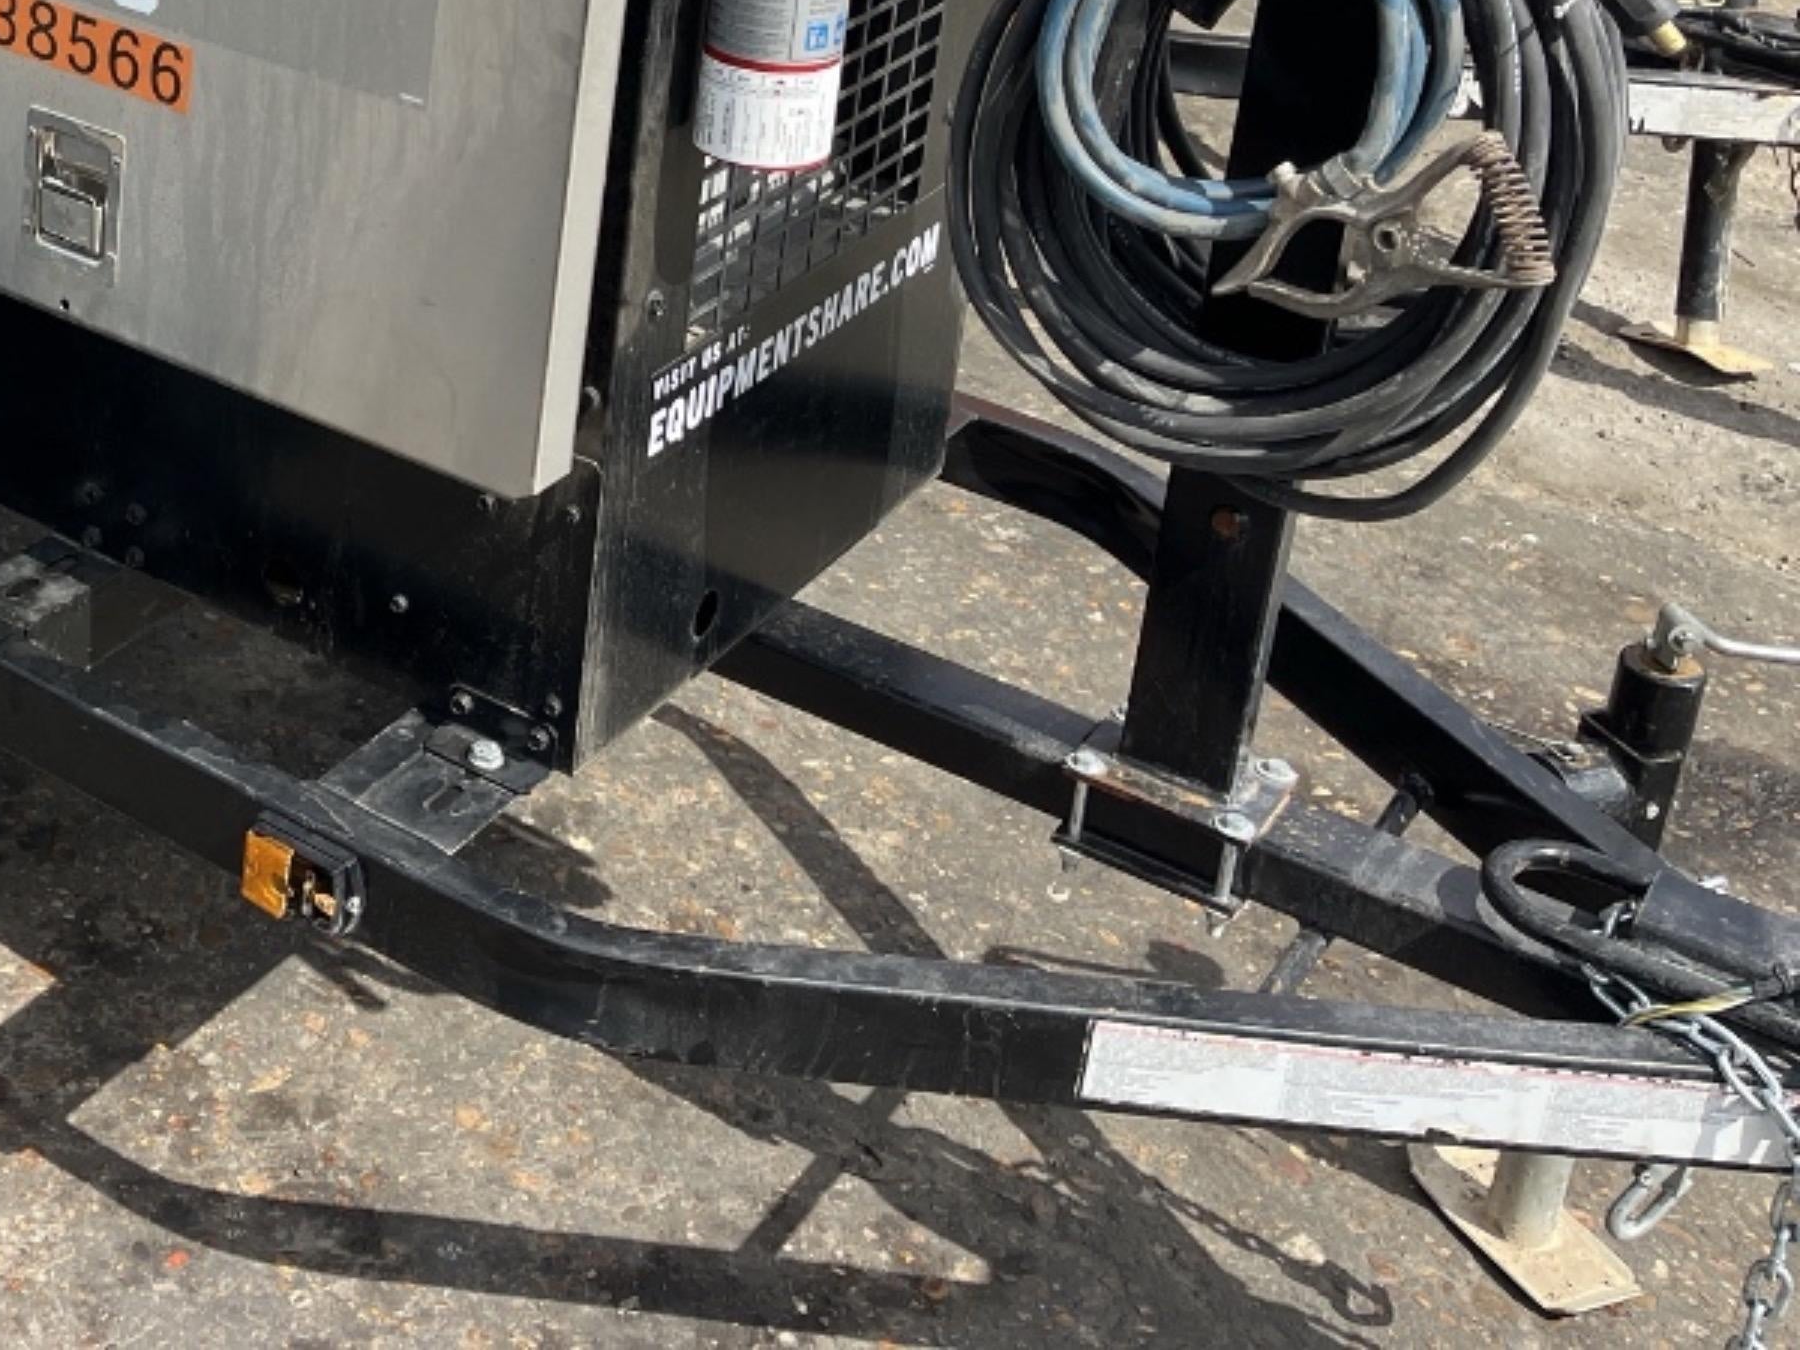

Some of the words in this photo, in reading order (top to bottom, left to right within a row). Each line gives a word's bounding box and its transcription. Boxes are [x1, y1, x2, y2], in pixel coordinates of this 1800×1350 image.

[647, 222, 941, 458] EQUIPMENTSHARE.COM
[653, 356, 698, 400] VISIT
[701, 341, 722, 370] US
